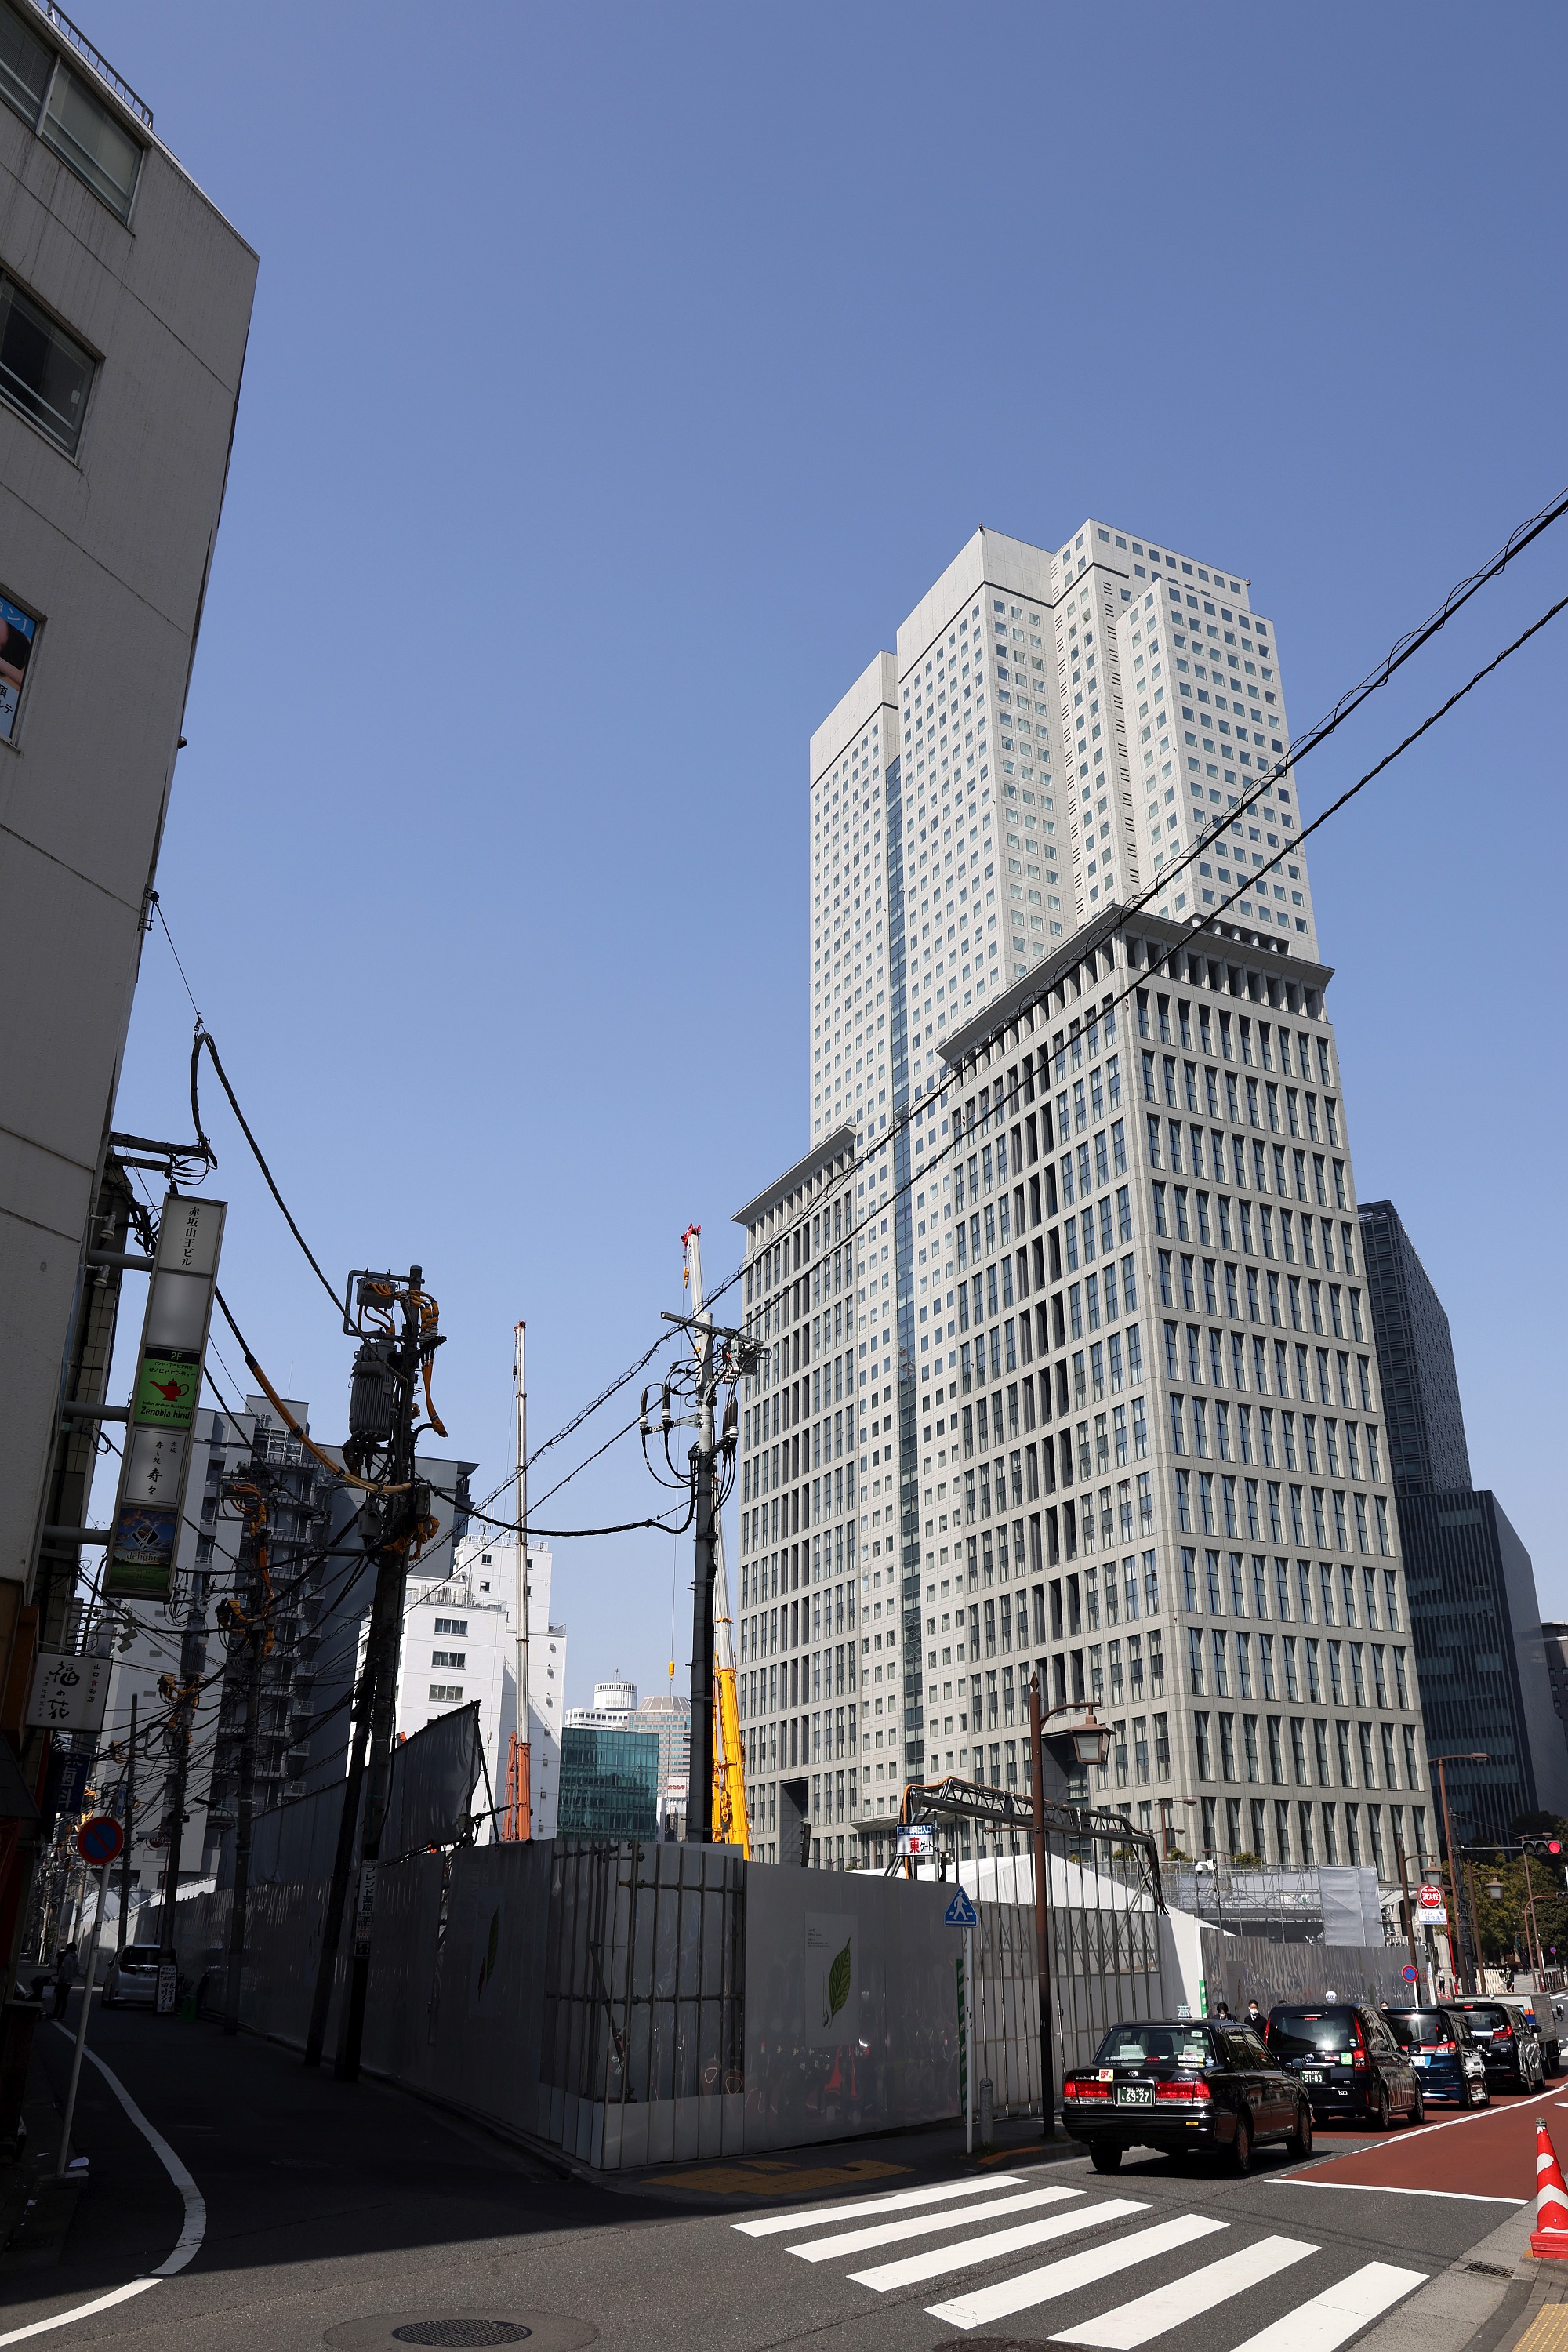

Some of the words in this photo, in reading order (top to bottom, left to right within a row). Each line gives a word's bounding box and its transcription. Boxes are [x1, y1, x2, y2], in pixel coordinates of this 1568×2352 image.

[180, 1207, 200, 1266] 赤坂山王ビル
[170, 1352, 183, 1361] 2F
[141, 1406, 171, 1418] Zenobia
[170, 1441, 177, 1454] 赤坂
[127, 1551, 158, 1564] delight
[48, 1661, 81, 1719] 福の花
[87, 1664, 101, 1703] 山口食彩店
[362, 1866, 376, 1911] フレンド薬局
[1421, 1892, 1440, 1901] 消火栓
[1126, 2092, 1149, 2102] 69-27
